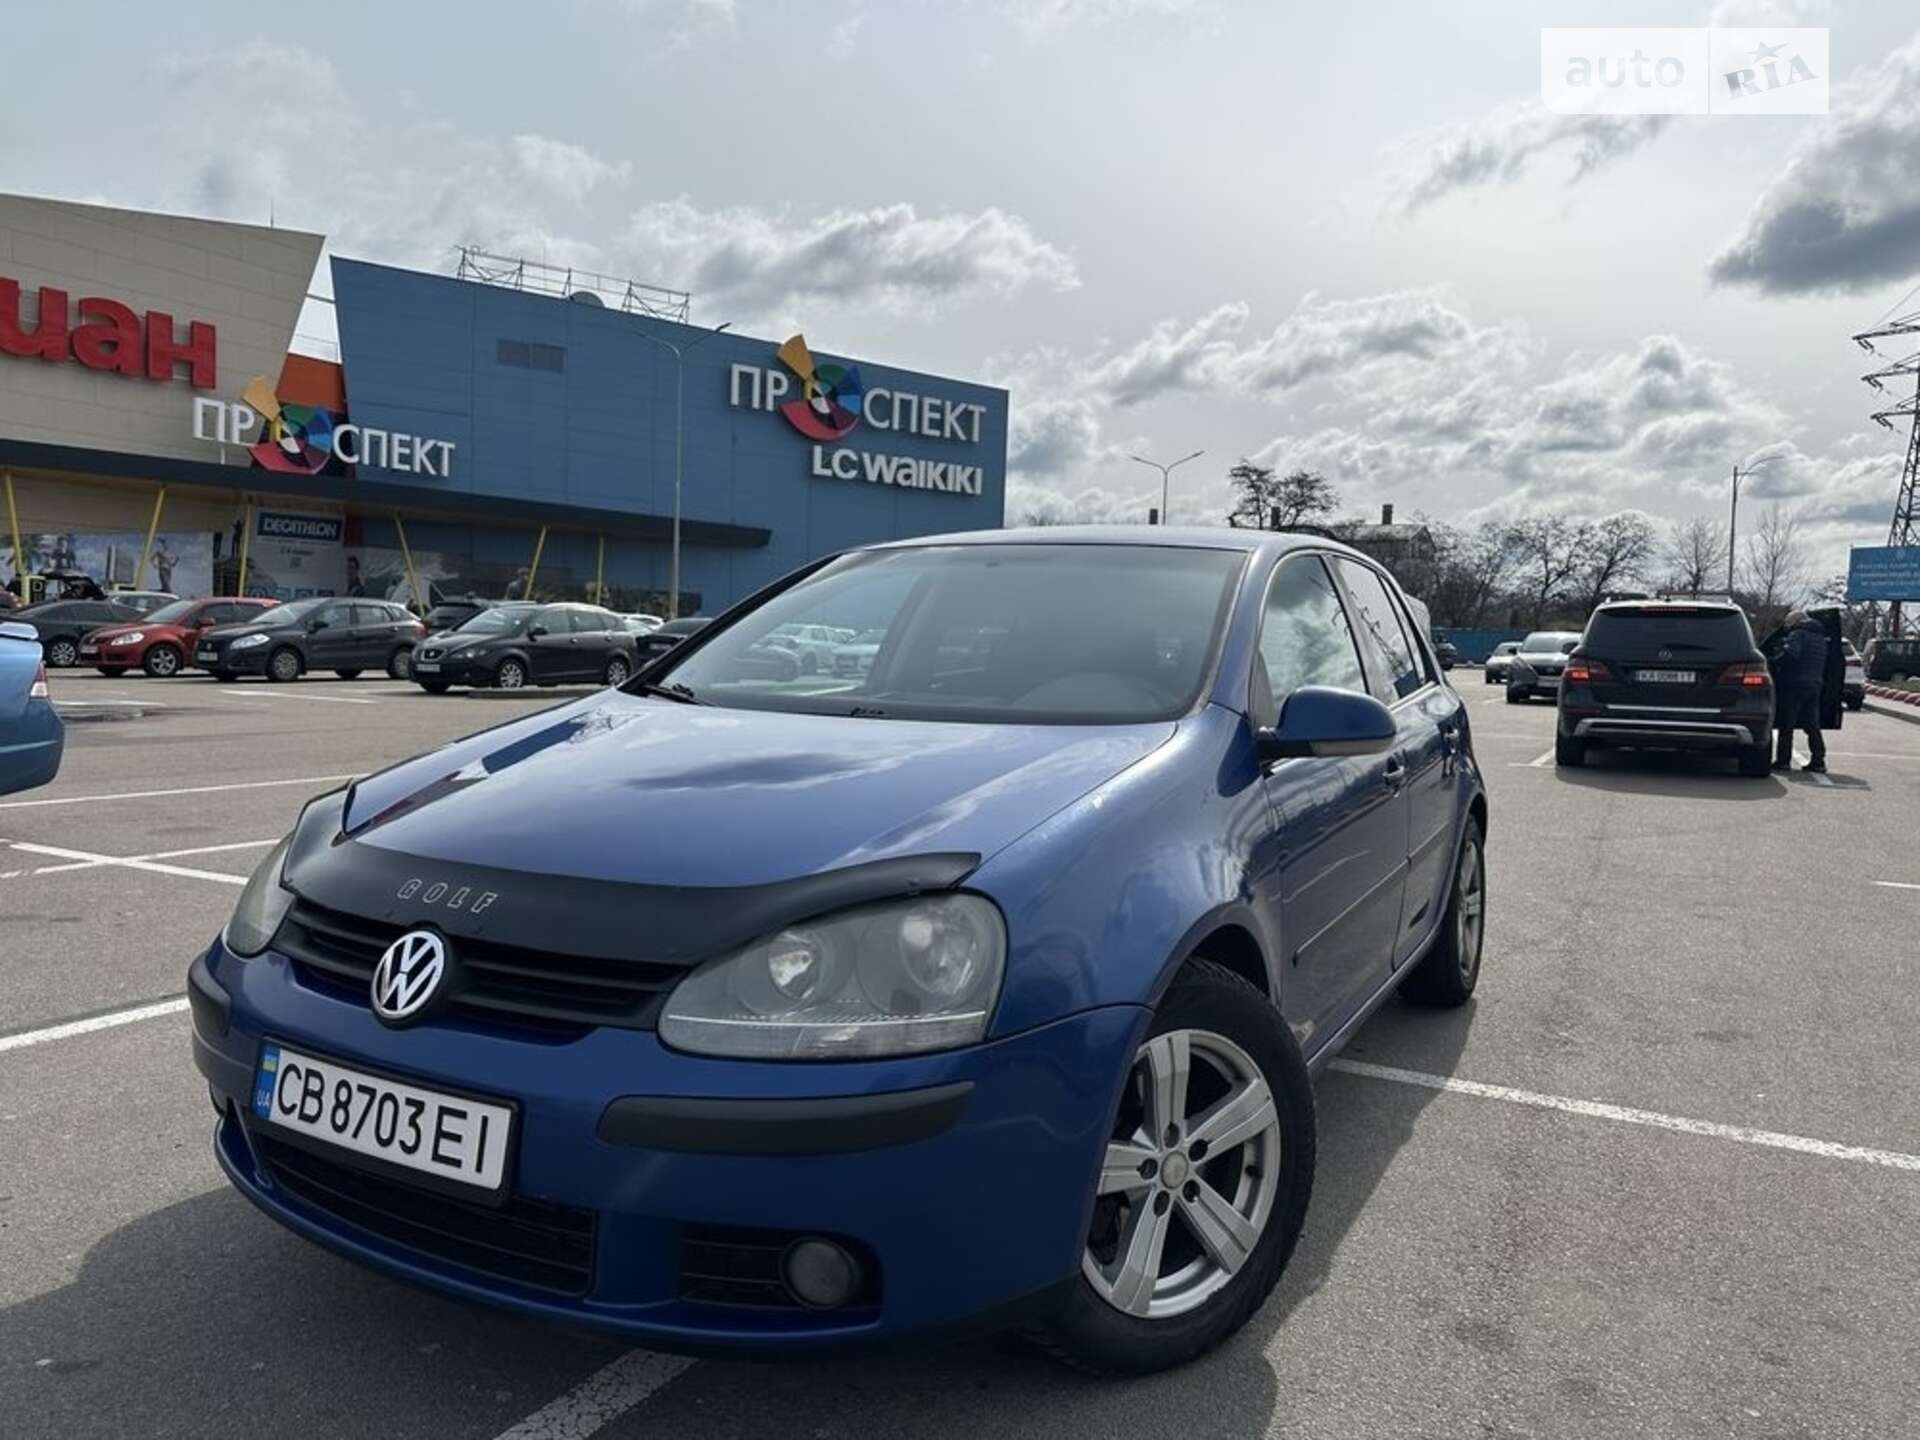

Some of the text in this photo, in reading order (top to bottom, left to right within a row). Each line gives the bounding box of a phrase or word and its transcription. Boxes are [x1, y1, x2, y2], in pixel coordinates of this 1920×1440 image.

[812, 445, 859, 480] LC
[262, 518, 338, 537] DECATHLON
[397, 878, 499, 914] GOLF
